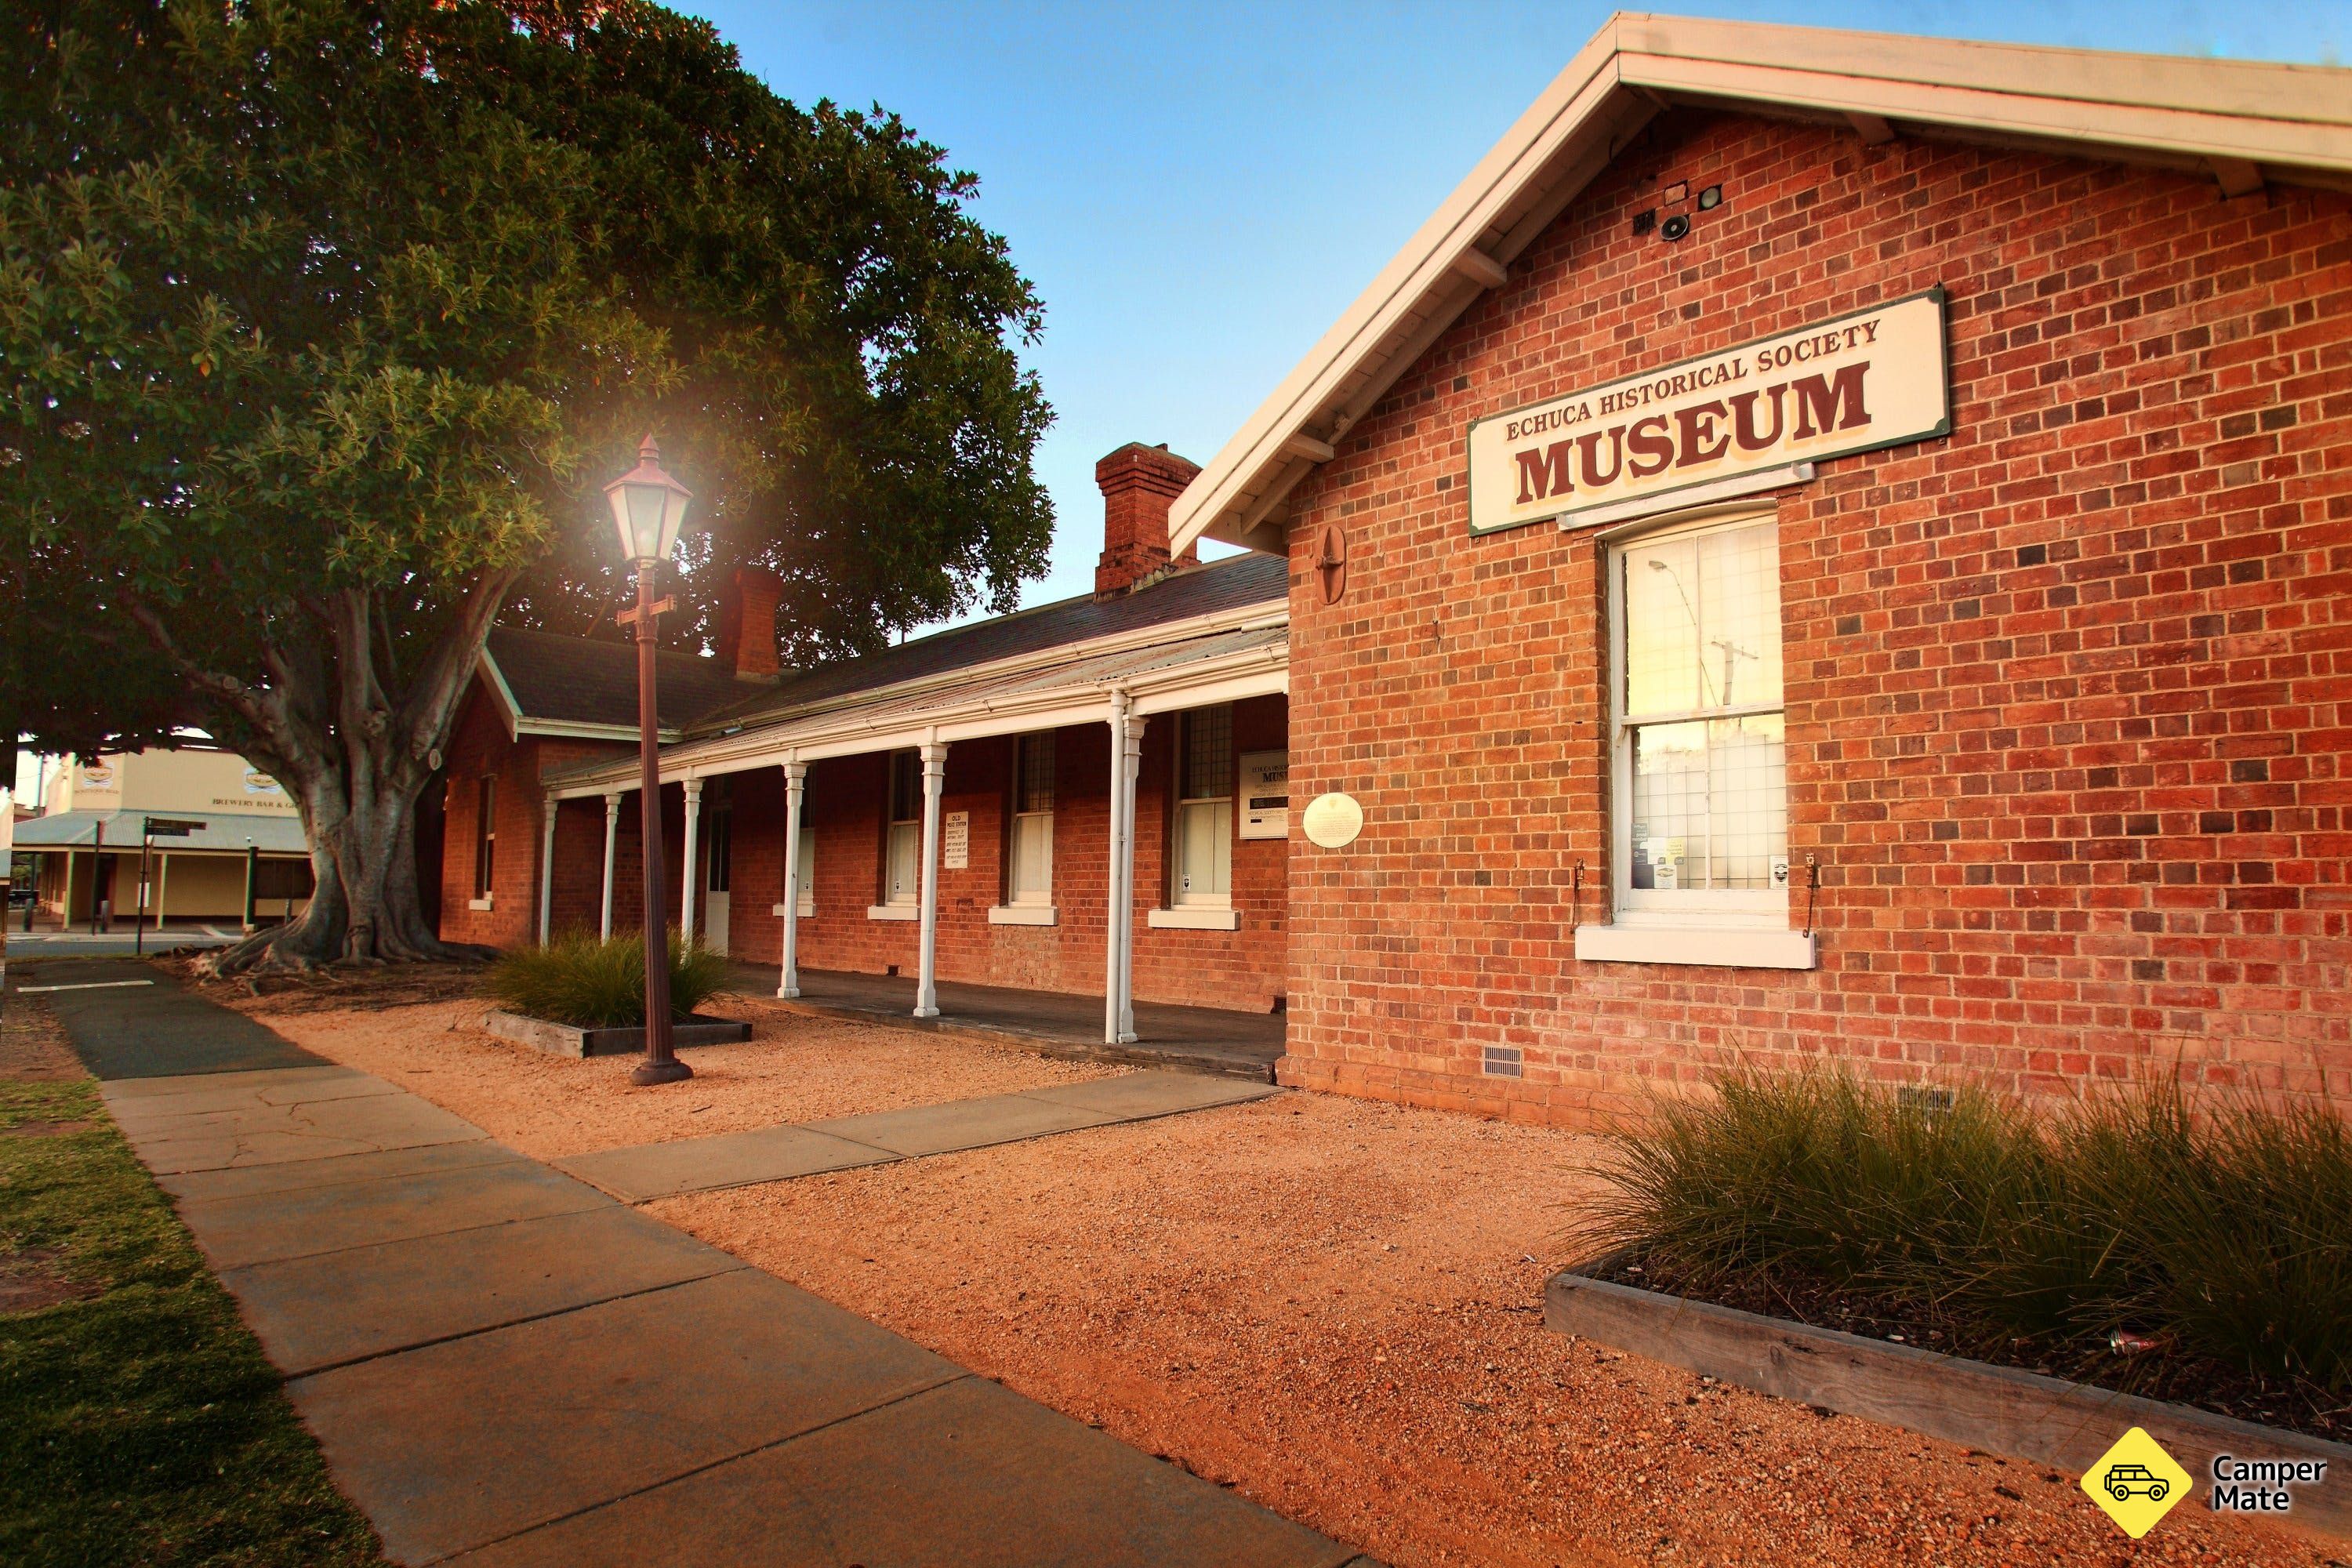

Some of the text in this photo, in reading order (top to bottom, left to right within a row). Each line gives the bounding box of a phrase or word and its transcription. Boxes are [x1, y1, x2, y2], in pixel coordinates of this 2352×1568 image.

[1506, 319, 1881, 441] ECHUCA HISTORICAL SOCIETY
[1515, 361, 1872, 505] MUSEUM
